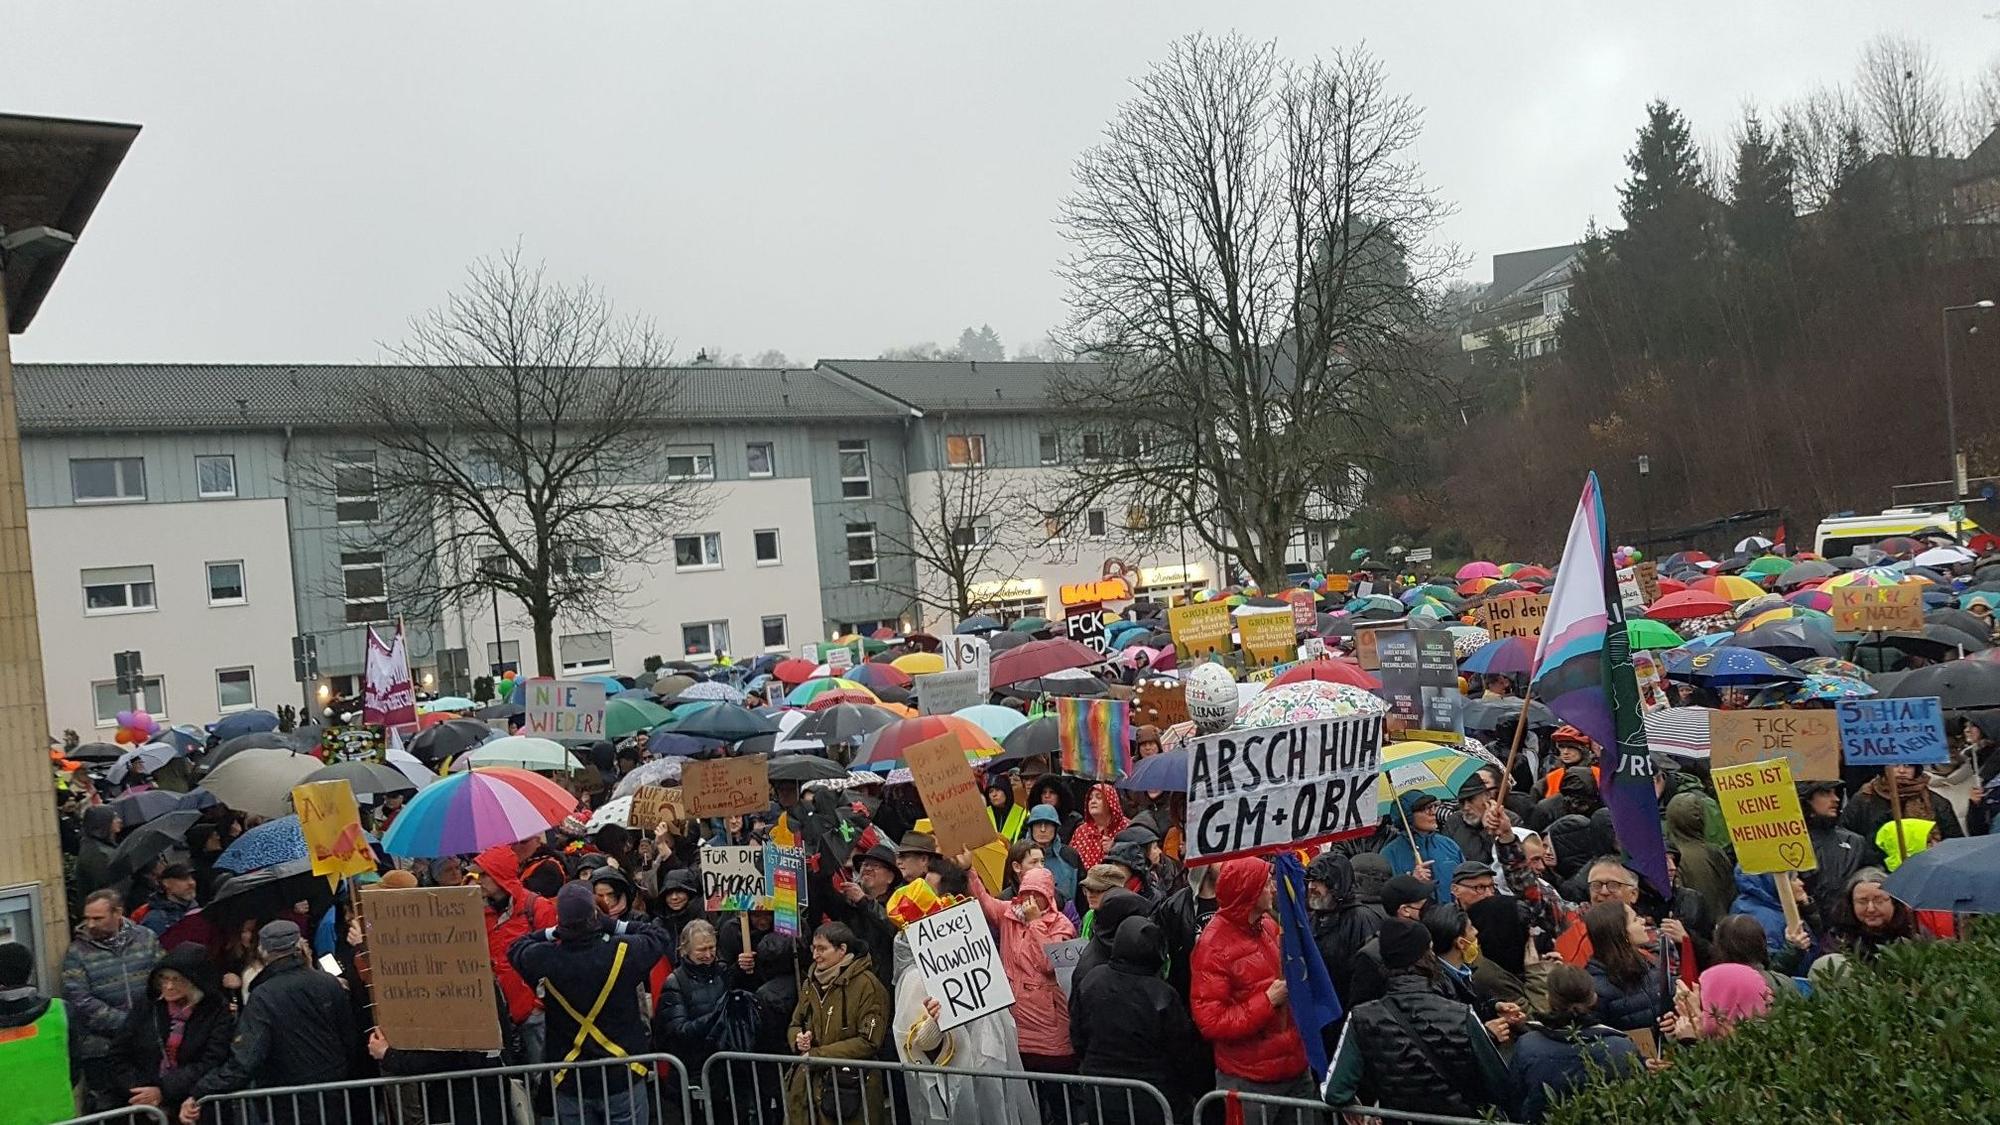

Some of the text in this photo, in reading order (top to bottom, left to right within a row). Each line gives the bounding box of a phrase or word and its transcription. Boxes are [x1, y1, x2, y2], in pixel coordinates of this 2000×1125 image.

[1488, 599, 1515, 620] Hol
[1067, 611, 1104, 637] FCK
[1493, 622, 1526, 640] Frau
[1254, 665, 1293, 683] ARSC
[536, 686, 577, 708] NIE
[529, 710, 604, 734] WIEDER!
[1763, 734, 1794, 749] DIE
[1848, 737, 1899, 757] SAGE
[1190, 716, 1382, 802] ARSCH HUH
[1716, 767, 1783, 792] HASS IST
[1737, 794, 1781, 816] KEINE
[1731, 818, 1808, 843] MEINUNG!
[702, 849, 761, 864] FÜR DIE
[375, 928, 401, 945] und
[446, 925, 478, 944] Zorn
[918, 909, 973, 947] Alexej
[918, 935, 992, 979] Nawalny
[942, 967, 992, 1018] RIP
